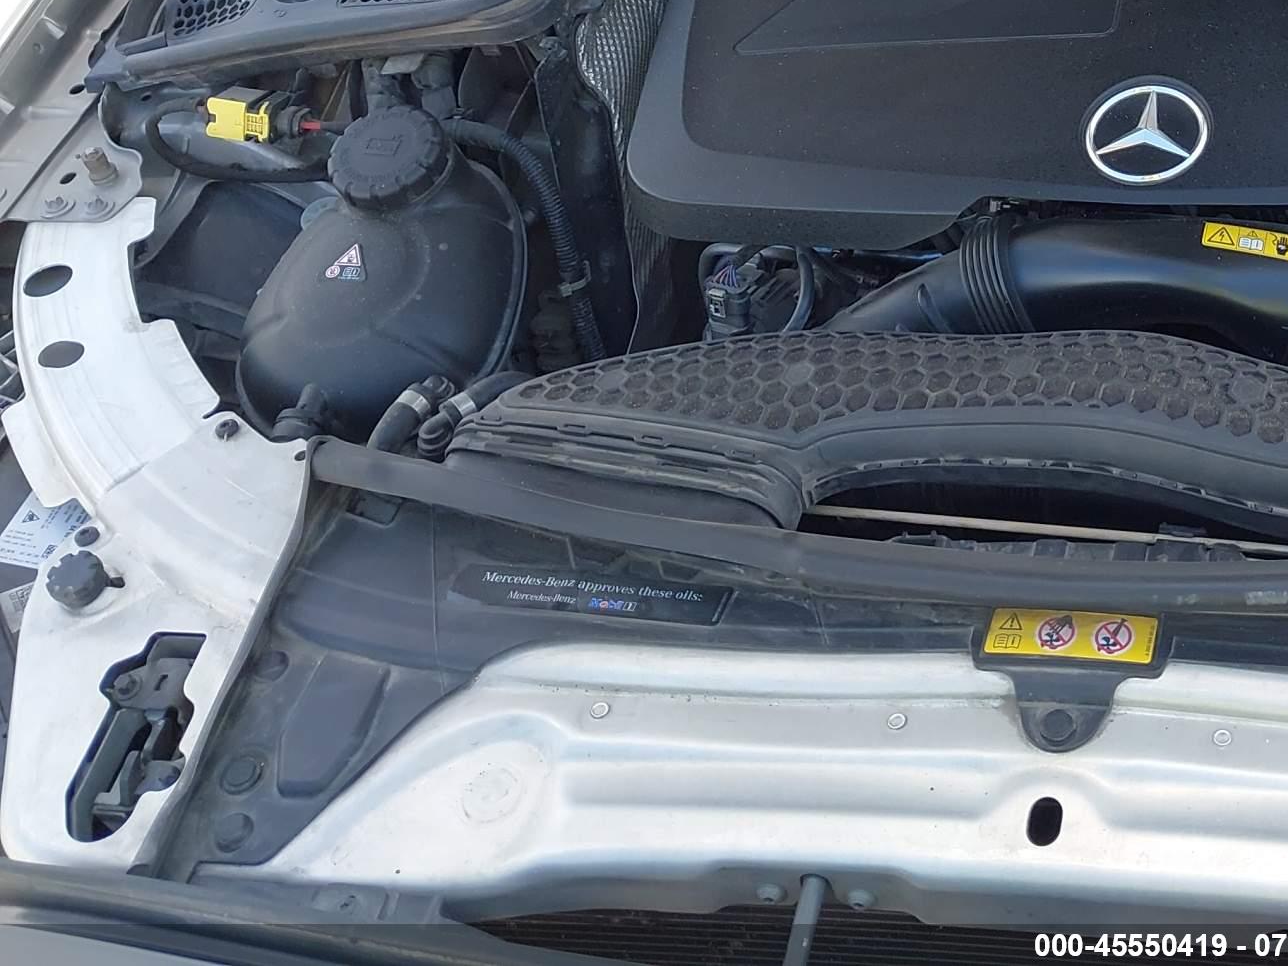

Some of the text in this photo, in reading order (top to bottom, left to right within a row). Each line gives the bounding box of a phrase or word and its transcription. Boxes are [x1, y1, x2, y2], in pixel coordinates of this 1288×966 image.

[482, 571, 703, 602] Mercedes-Benz approves these oils:
[507, 590, 576, 604] Mercedes-Benz
